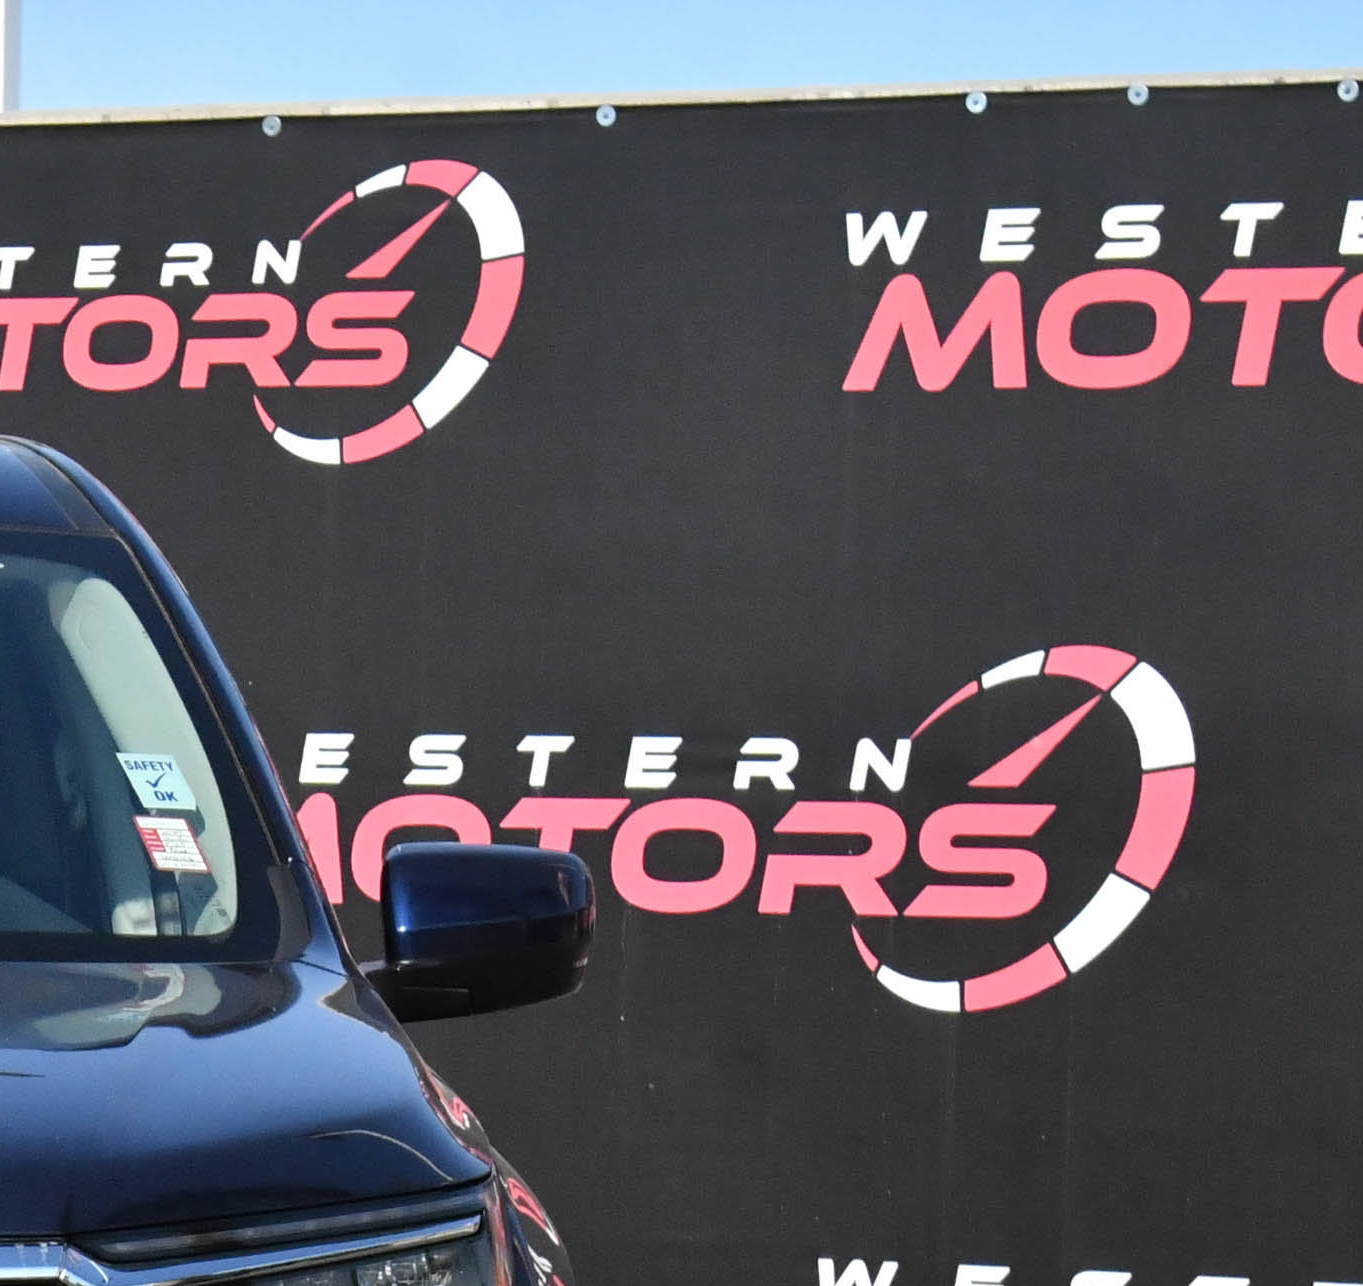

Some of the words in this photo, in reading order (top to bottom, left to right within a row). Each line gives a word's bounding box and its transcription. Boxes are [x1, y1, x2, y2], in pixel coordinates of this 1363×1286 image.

[842, 266, 1363, 393] MOT
[124, 759, 175, 773] SAFETY
[154, 790, 179, 802] OK
